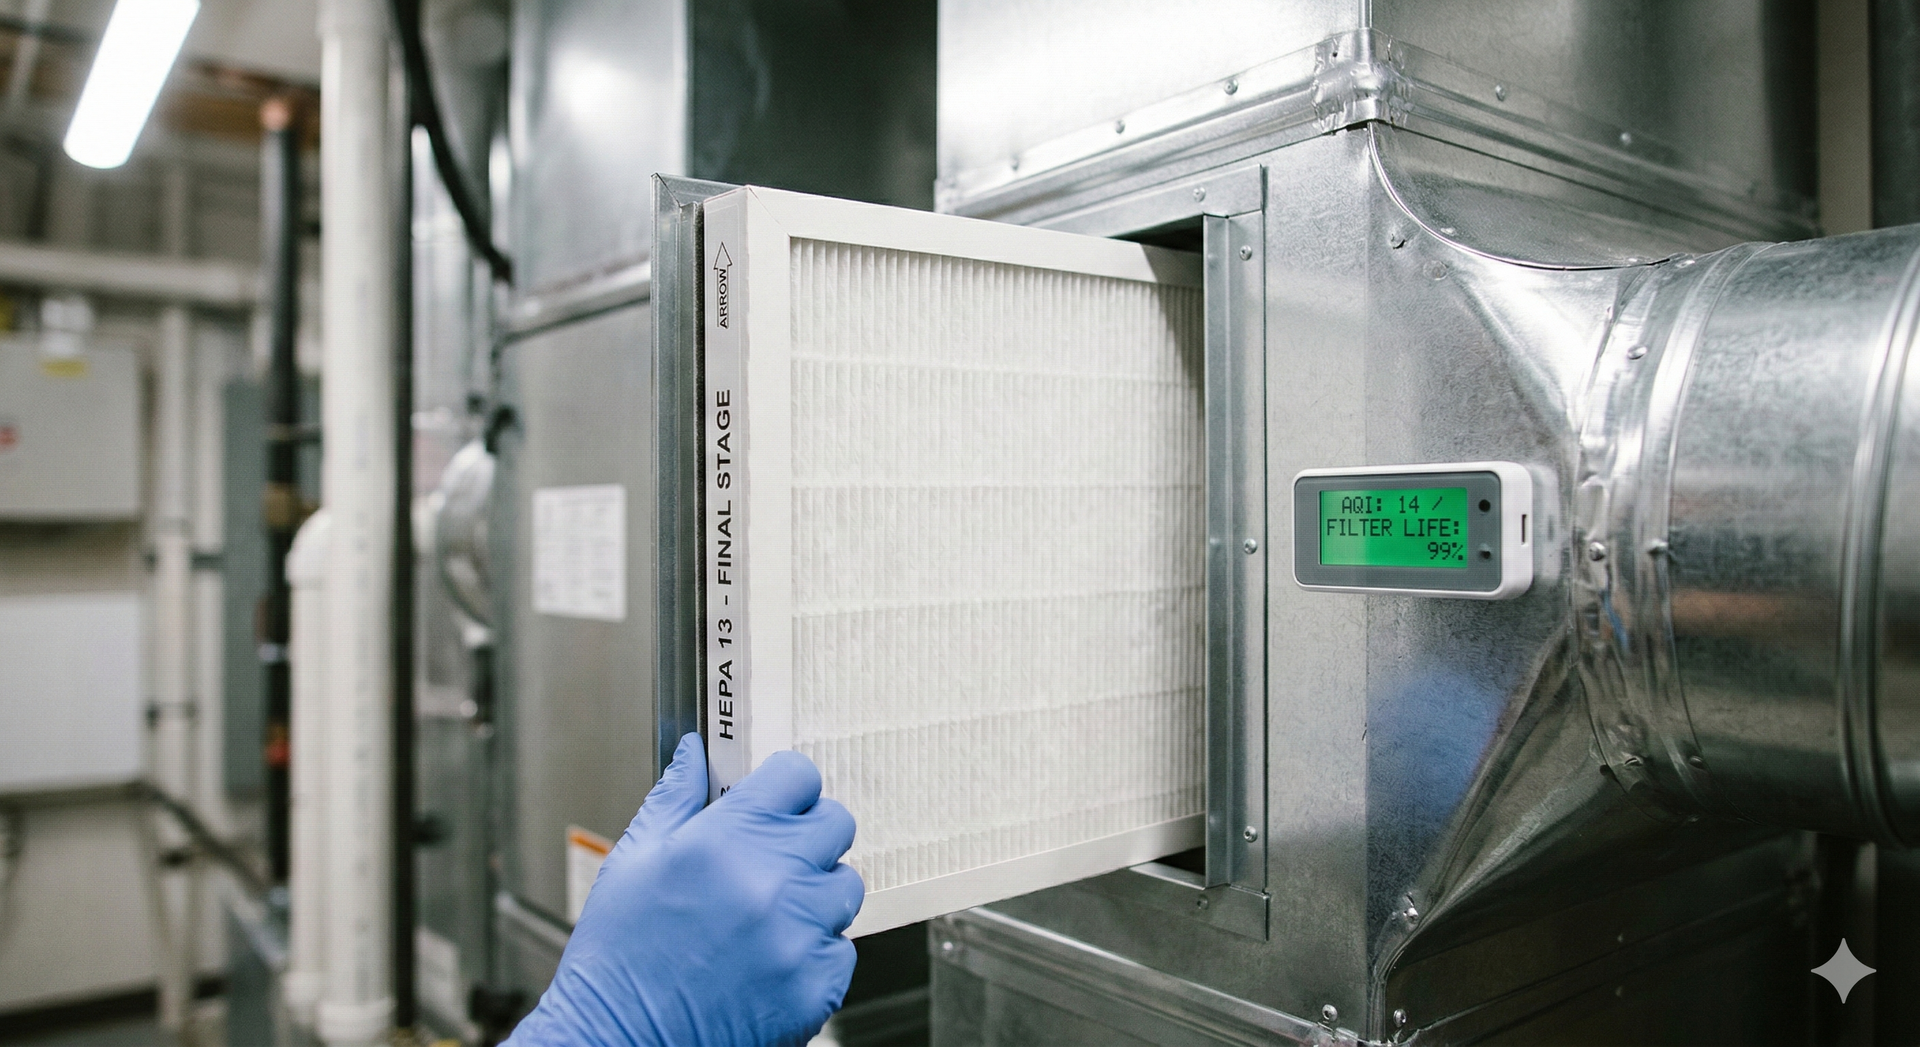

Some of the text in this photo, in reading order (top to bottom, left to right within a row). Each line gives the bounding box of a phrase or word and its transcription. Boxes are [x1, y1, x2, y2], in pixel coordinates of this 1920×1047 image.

[718, 268, 729, 329] ARROW
[716, 389, 732, 490] STAGE
[1327, 518, 1459, 537] FILTER LIFE:
[1341, 495, 1443, 514] AQI: 14 /
[717, 499, 732, 586] FINAL
[1427, 541, 1464, 561] 99%
[717, 618, 733, 649] 13
[718, 659, 734, 741] HEPA
